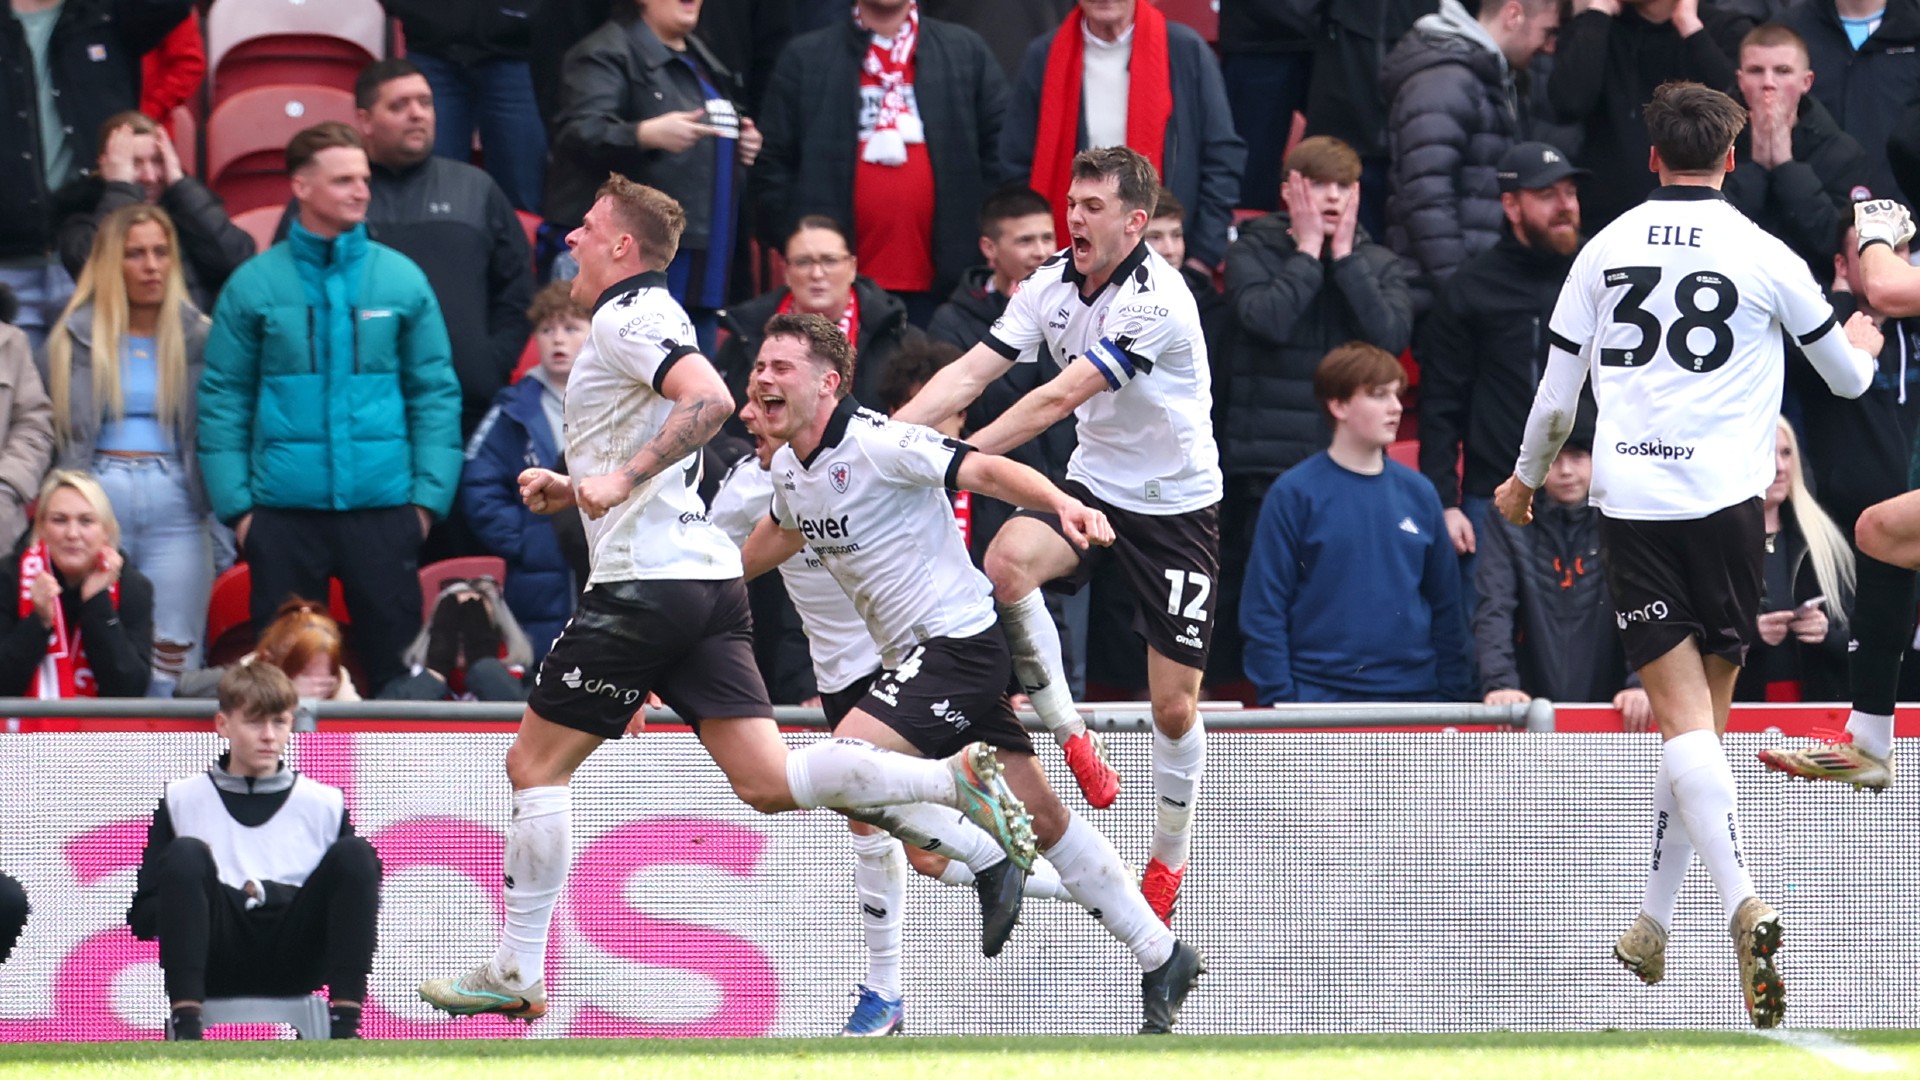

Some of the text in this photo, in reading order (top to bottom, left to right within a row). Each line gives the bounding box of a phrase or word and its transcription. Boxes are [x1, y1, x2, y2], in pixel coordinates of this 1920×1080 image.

[1647, 225, 1704, 248] EILE
[1600, 265, 1740, 374] 38
[1615, 439, 1696, 461] GoSkippy
[1164, 568, 1211, 622] 12
[1652, 811, 1669, 871] ROBINS
[1727, 812, 1745, 868] ROBINS
